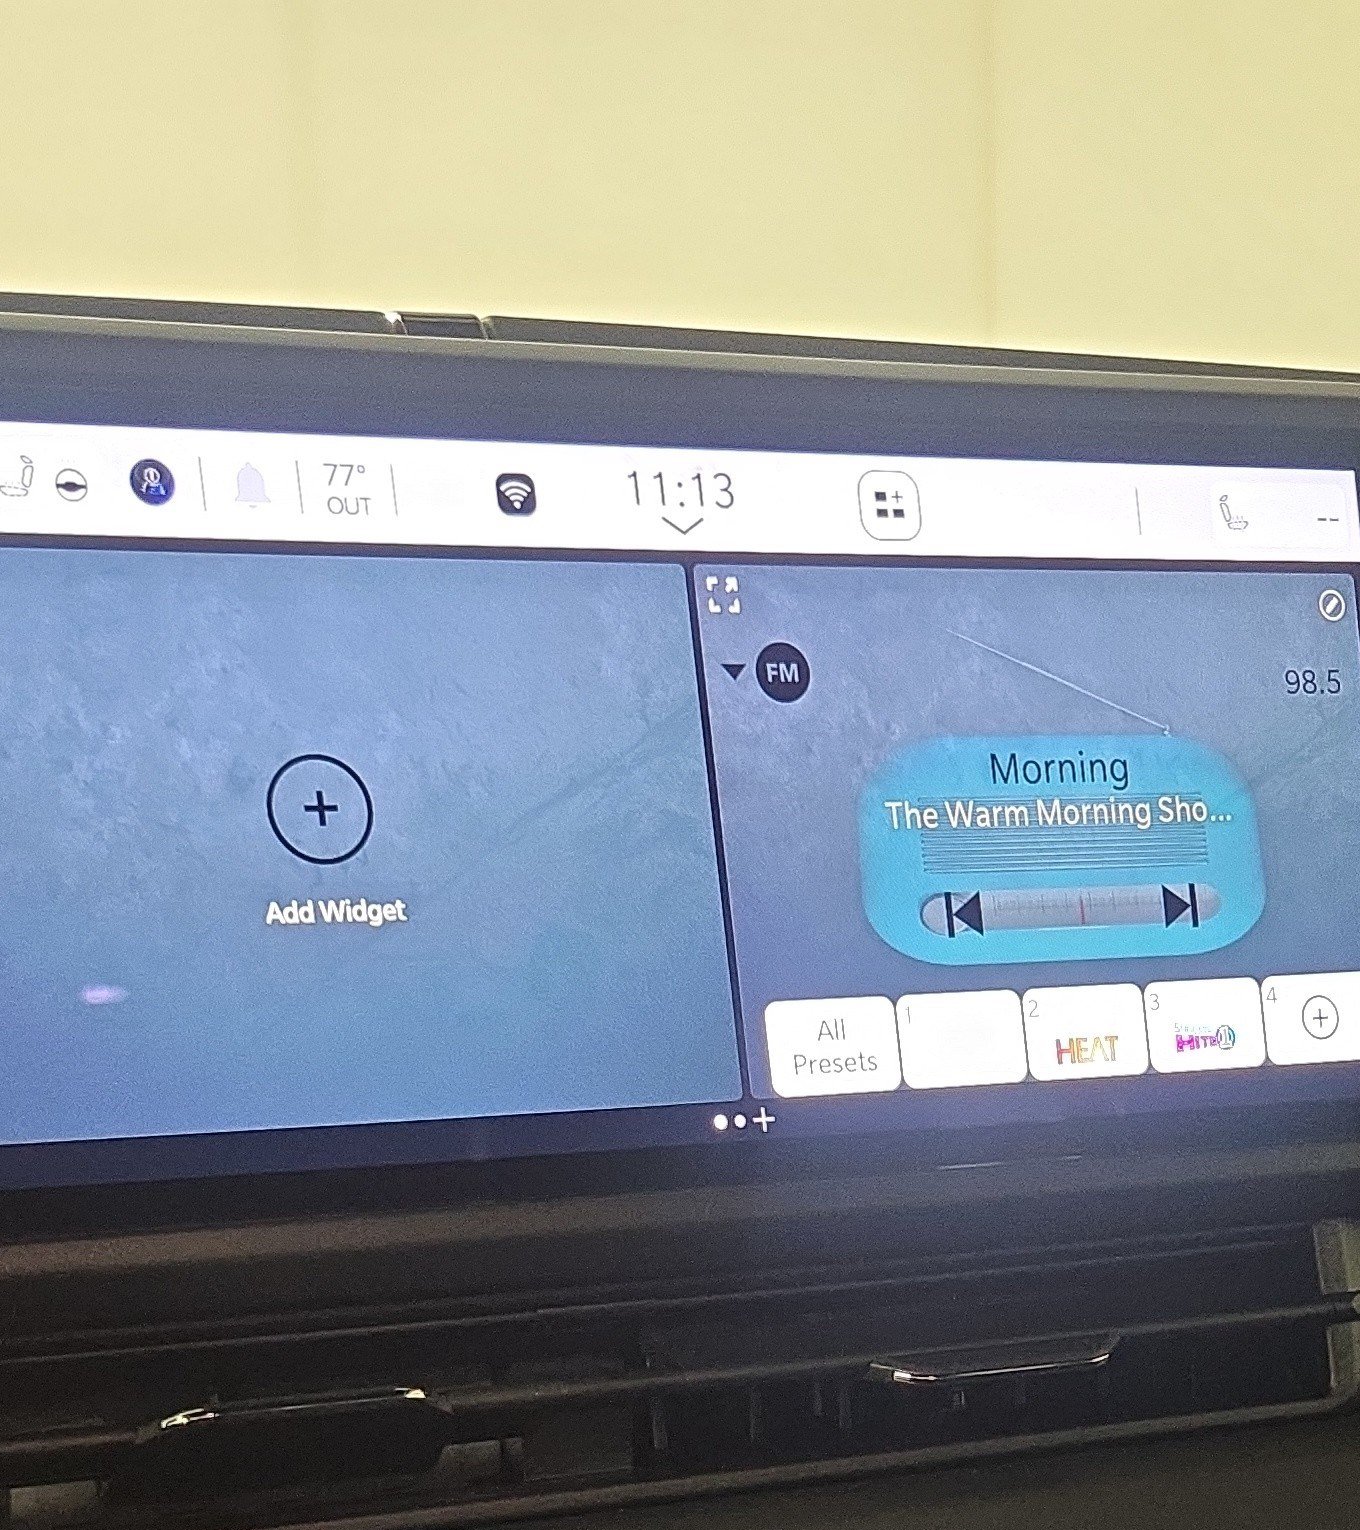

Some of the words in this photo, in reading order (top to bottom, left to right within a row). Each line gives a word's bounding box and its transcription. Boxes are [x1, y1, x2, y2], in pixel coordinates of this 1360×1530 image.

[321, 462, 367, 488] 77°
[626, 469, 736, 510] 11:13
[326, 495, 372, 516] OUT
[765, 662, 801, 685] FM
[1283, 668, 1342, 696] 98.5
[990, 750, 1130, 790] Morning
[885, 800, 939, 829] The
[945, 800, 1030, 828] Warm
[1037, 797, 1152, 831] Morning
[265, 899, 316, 925] Add
[317, 897, 409, 927] Widget
[1149, 993, 1160, 1011] 3
[1266, 986, 1277, 1003] 4
[1028, 999, 1040, 1018] 2
[816, 1017, 848, 1043] All
[793, 1048, 879, 1077] Presets
[1055, 1035, 1119, 1065] HEAT
